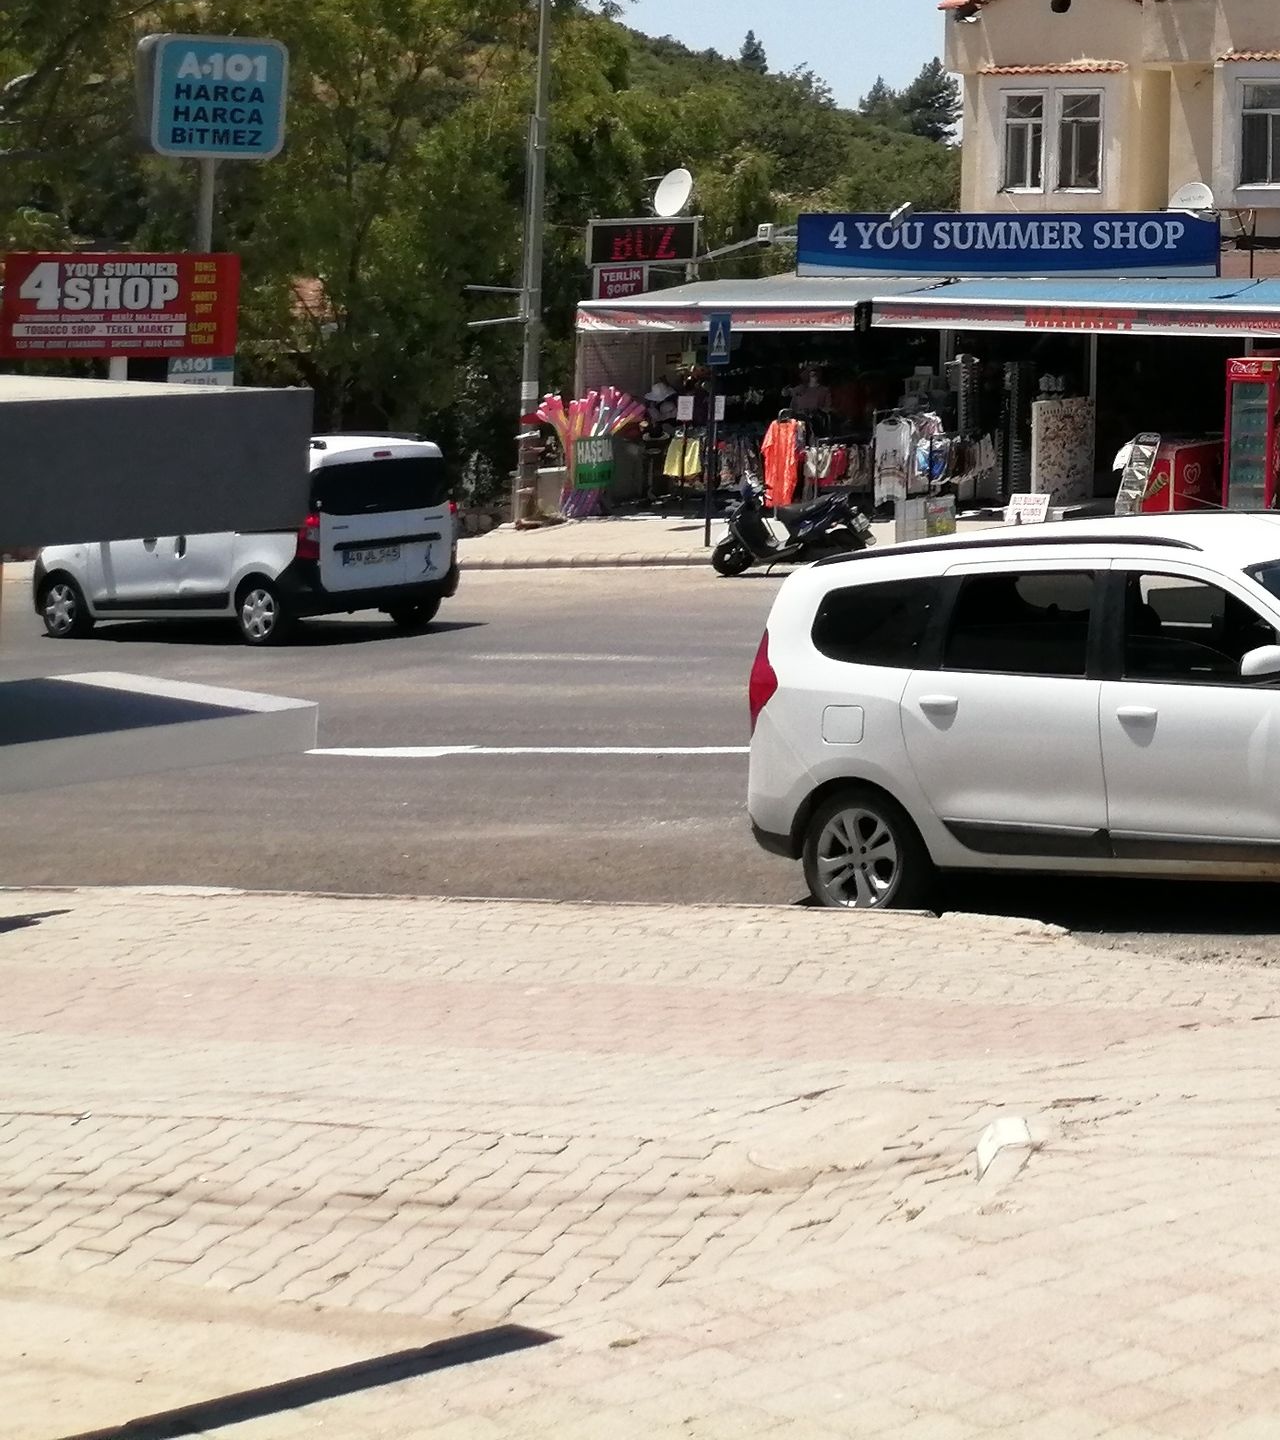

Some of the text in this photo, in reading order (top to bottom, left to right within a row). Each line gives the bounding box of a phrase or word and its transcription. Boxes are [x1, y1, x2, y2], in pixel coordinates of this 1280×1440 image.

[174, 83, 265, 103] HARCA
[173, 105, 263, 125] HARCA
[829, 221, 1185, 250] 4 YOU SUMMER SHOP
[64, 262, 178, 277] YOU SUMMER
[602, 269, 640, 282] TERLİK
[19, 262, 60, 310] 4
[63, 277, 179, 310] SHOP
[607, 283, 635, 295] ŞORT
[26, 326, 67, 334] TOBACCO
[71, 326, 96, 334] SHOP
[137, 326, 174, 334] MARKET
